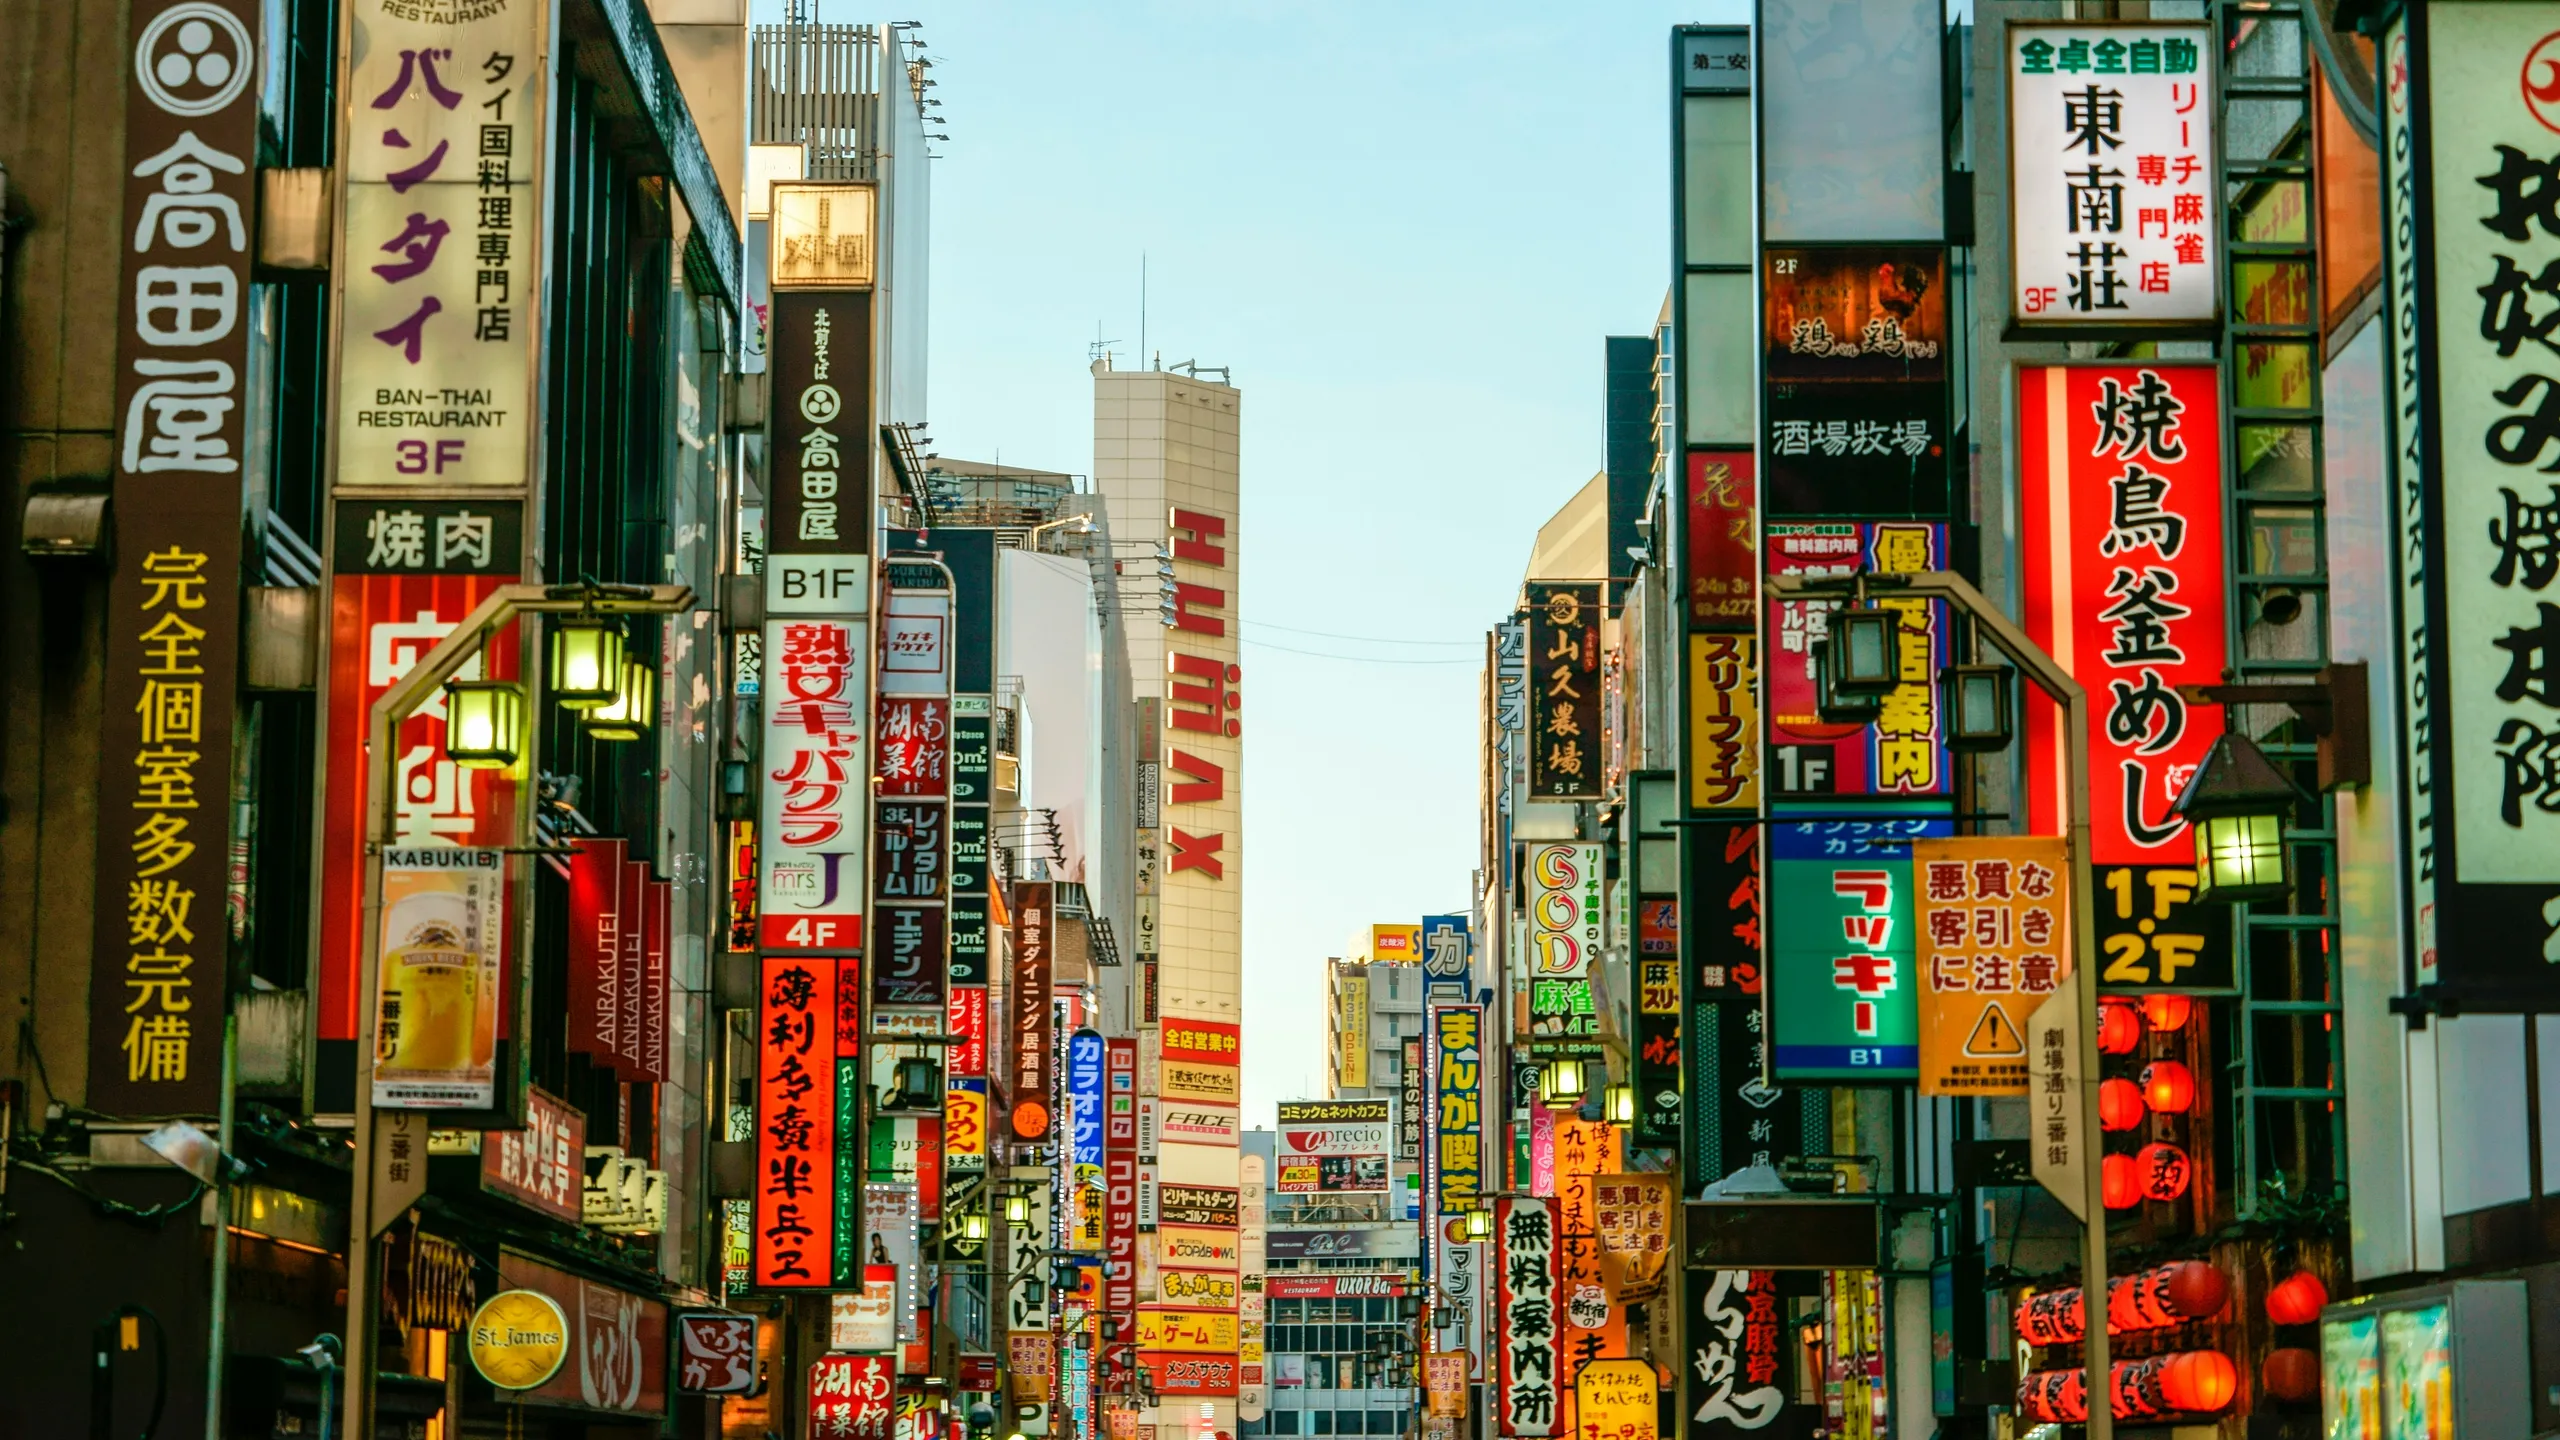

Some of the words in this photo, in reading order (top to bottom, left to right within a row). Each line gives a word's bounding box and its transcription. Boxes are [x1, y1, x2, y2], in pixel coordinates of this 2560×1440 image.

[1693, 53, 1750, 71] 第二安
[2020, 38, 2199, 75] 全卓全自動
[2171, 82, 2206, 266] リーチ麻雀
[371, 48, 463, 364] バンタイ
[474, 51, 514, 342] タイ国料理専門店
[2061, 84, 2129, 313] 東南荘
[2136, 154, 2171, 294] 専門店
[1775, 259, 1798, 274] 2F
[122, 130, 246, 473] 高田屋
[2025, 287, 2058, 313] 3F
[814, 308, 830, 381] 北前そば
[376, 388, 492, 406] BAN-THAI
[358, 411, 507, 428] RESTAURANT
[1772, 420, 1932, 456] 酒場牧場
[396, 440, 465, 475] 3F
[800, 427, 840, 542] 高田屋
[367, 509, 493, 569] 焼肉
[1784, 539, 1859, 553] 無料案内所
[783, 569, 855, 599] B1F
[2092, 370, 2191, 850] 焼鳥釜めし
[1546, 628, 1583, 776] 山久農場
[1704, 635, 1749, 806] スリーファイブ
[771, 624, 863, 849] 熟女キャバクラ
[880, 702, 946, 742] 湖南
[879, 743, 945, 780] 菜館
[1778, 746, 1828, 791] 1F
[955, 785, 968, 794] 5F
[1553, 783, 1580, 794] 5F
[120, 545, 209, 1082] 完全個室多数完備
[885, 808, 908, 822] 3F
[884, 829, 908, 895] ルーム
[913, 806, 938, 895] レンタル
[1825, 837, 1902, 854] カフェ
[1585, 849, 1600, 924] リーチ麻雀
[1928, 861, 2055, 902] 悪質な
[1535, 845, 1580, 973] GOD
[785, 923, 837, 947] 4F
[893, 911, 922, 977] エデン
[1928, 906, 2056, 950] 客引き
[1833, 870, 1893, 1035] ラッキー
[2103, 932, 2206, 985] 2F
[596, 911, 617, 1045] ANRAKUTEI
[1931, 954, 2060, 994] に注意
[838, 967, 858, 1043] 炭火串焼
[1020, 907, 1041, 1089] 個室ダイニング居酒屋
[1532, 979, 1595, 1015] 麻雀
[1165, 1028, 1237, 1054] 全店営業中
[1850, 1048, 1883, 1065] B1
[1074, 1037, 1100, 1142] カラオケ
[1403, 1070, 1420, 1142] 北の家族
[2043, 1025, 2070, 1168] 劇場通り一番街
[1165, 1112, 1237, 1128] FACE
[1280, 1104, 1388, 1120] コミック&ネットカフェ
[1440, 1012, 1479, 1213] まんが喫茶
[874, 1140, 939, 1151] イタリアン
[1141, 1115, 1151, 1151] MARUHAN
[1141, 1183, 1151, 1220] MARUHAN
[1162, 1188, 1238, 1209] ビリヤード&ダーツ
[1599, 1186, 1663, 1206] 悪質な
[1185, 1209, 1210, 1223] ゴルフ
[1599, 1210, 1664, 1230] 客引き
[1602, 1234, 1665, 1253] に注意
[1164, 1272, 1235, 1298] まんが喫茶
[1335, 1275, 1370, 1297] LUXOR
[1508, 1209, 1551, 1424] 無料案内所
[1571, 1300, 1607, 1318] 新宿
[1163, 1323, 1209, 1345] ゲーム
[813, 1358, 890, 1400] 湖南
[978, 1379, 994, 1389] 2F
[1166, 1361, 1232, 1379] メンズサウナ
[1583, 1372, 1644, 1388] お好み焼
[830, 1403, 888, 1438] 菜館
